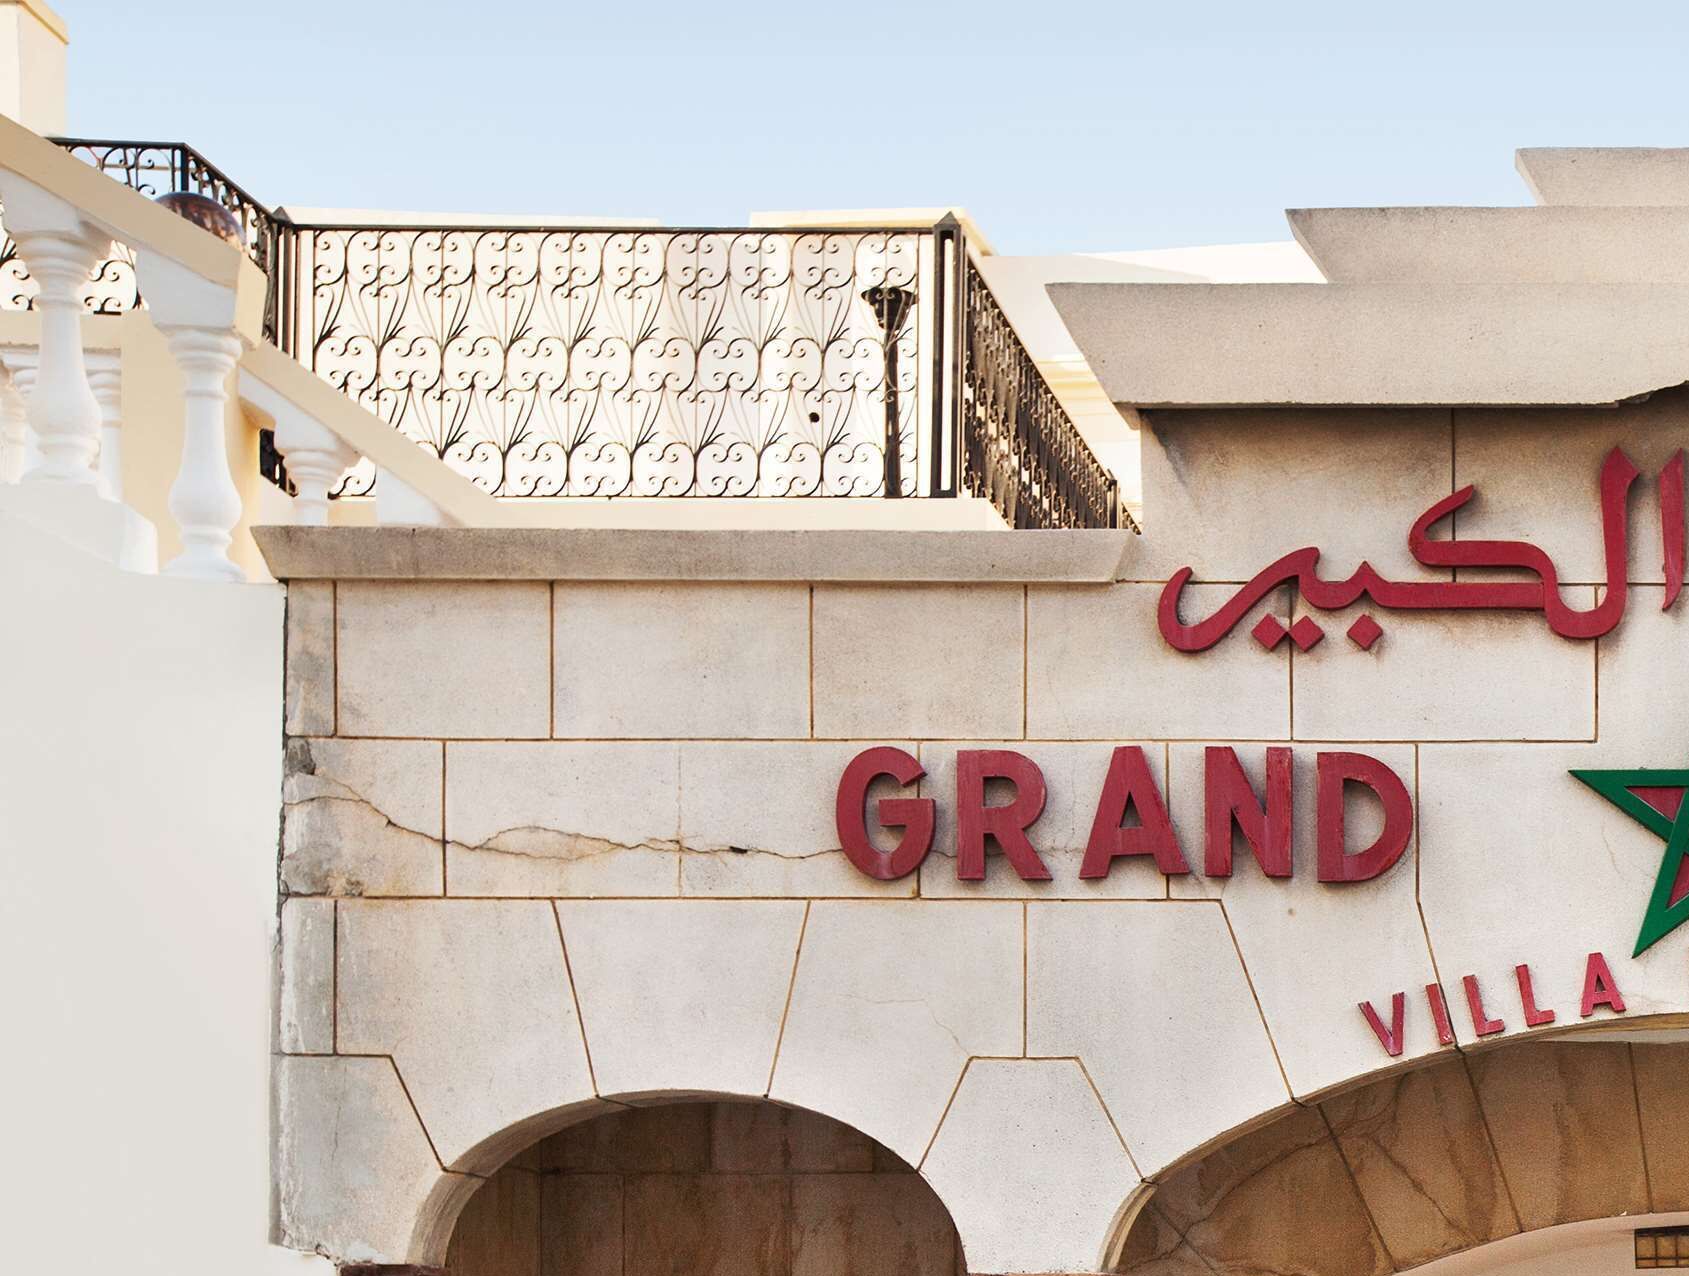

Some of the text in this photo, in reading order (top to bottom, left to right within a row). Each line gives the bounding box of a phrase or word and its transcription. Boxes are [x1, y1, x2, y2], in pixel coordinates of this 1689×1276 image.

[1158, 445, 1688, 653] الكبير
[835, 745, 1415, 882] GRAND
[1362, 952, 1627, 1058] VILLA
